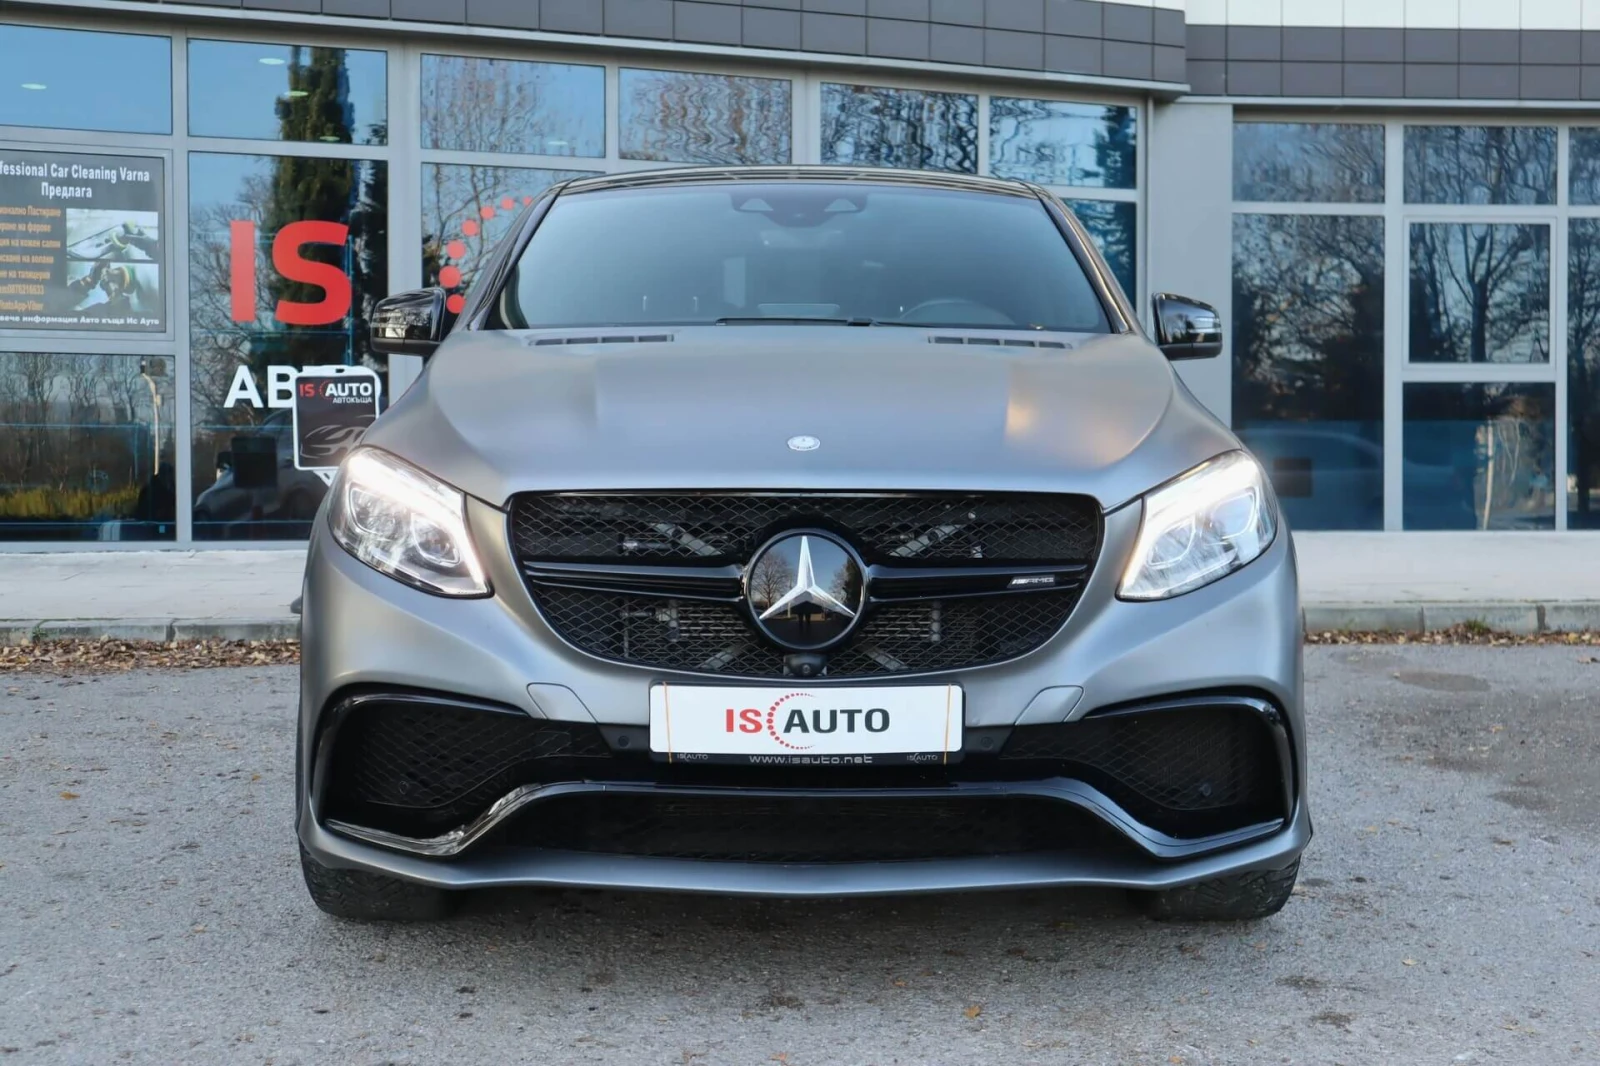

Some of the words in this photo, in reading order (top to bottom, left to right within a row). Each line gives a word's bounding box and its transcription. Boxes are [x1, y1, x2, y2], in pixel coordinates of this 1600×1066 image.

[50, 163, 69, 178] Car
[71, 164, 117, 184] Cleaning
[119, 166, 150, 182] Varna
[41, 182, 92, 199] Предлага
[230, 220, 352, 325] IS
[22, 315, 78, 324] информация
[80, 315, 99, 323] Авто
[140, 317, 159, 326] Ауто
[299, 383, 315, 397] IS
[325, 382, 373, 397] AUTO
[726, 708, 763, 733] IS
[783, 708, 890, 733] AUTO
[749, 754, 873, 764] www.isauto.net
